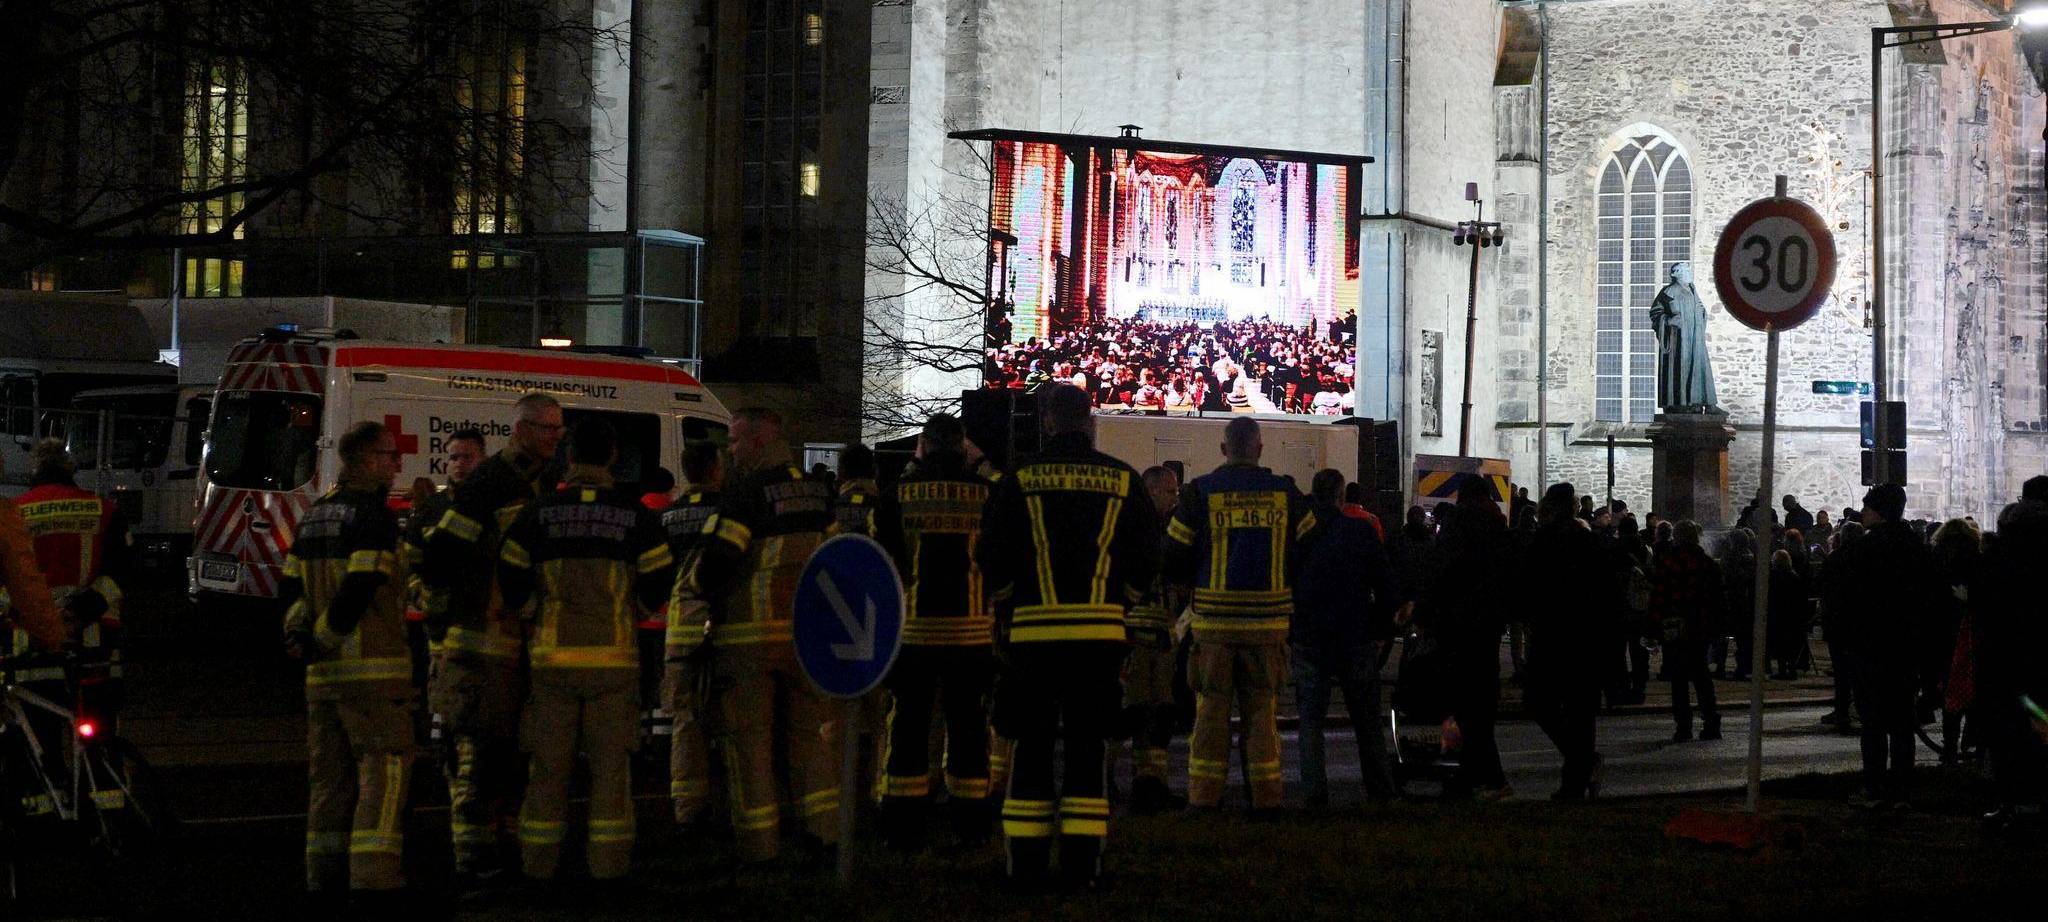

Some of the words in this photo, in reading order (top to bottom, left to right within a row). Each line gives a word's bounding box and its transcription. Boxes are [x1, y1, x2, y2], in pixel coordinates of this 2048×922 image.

[1740, 235, 1808, 292] 30
[447, 376, 618, 399] KATASTROPHENSCHUTZ
[900, 482, 986, 499] FEUERWEHR
[1216, 510, 1283, 528] 01-46-02
